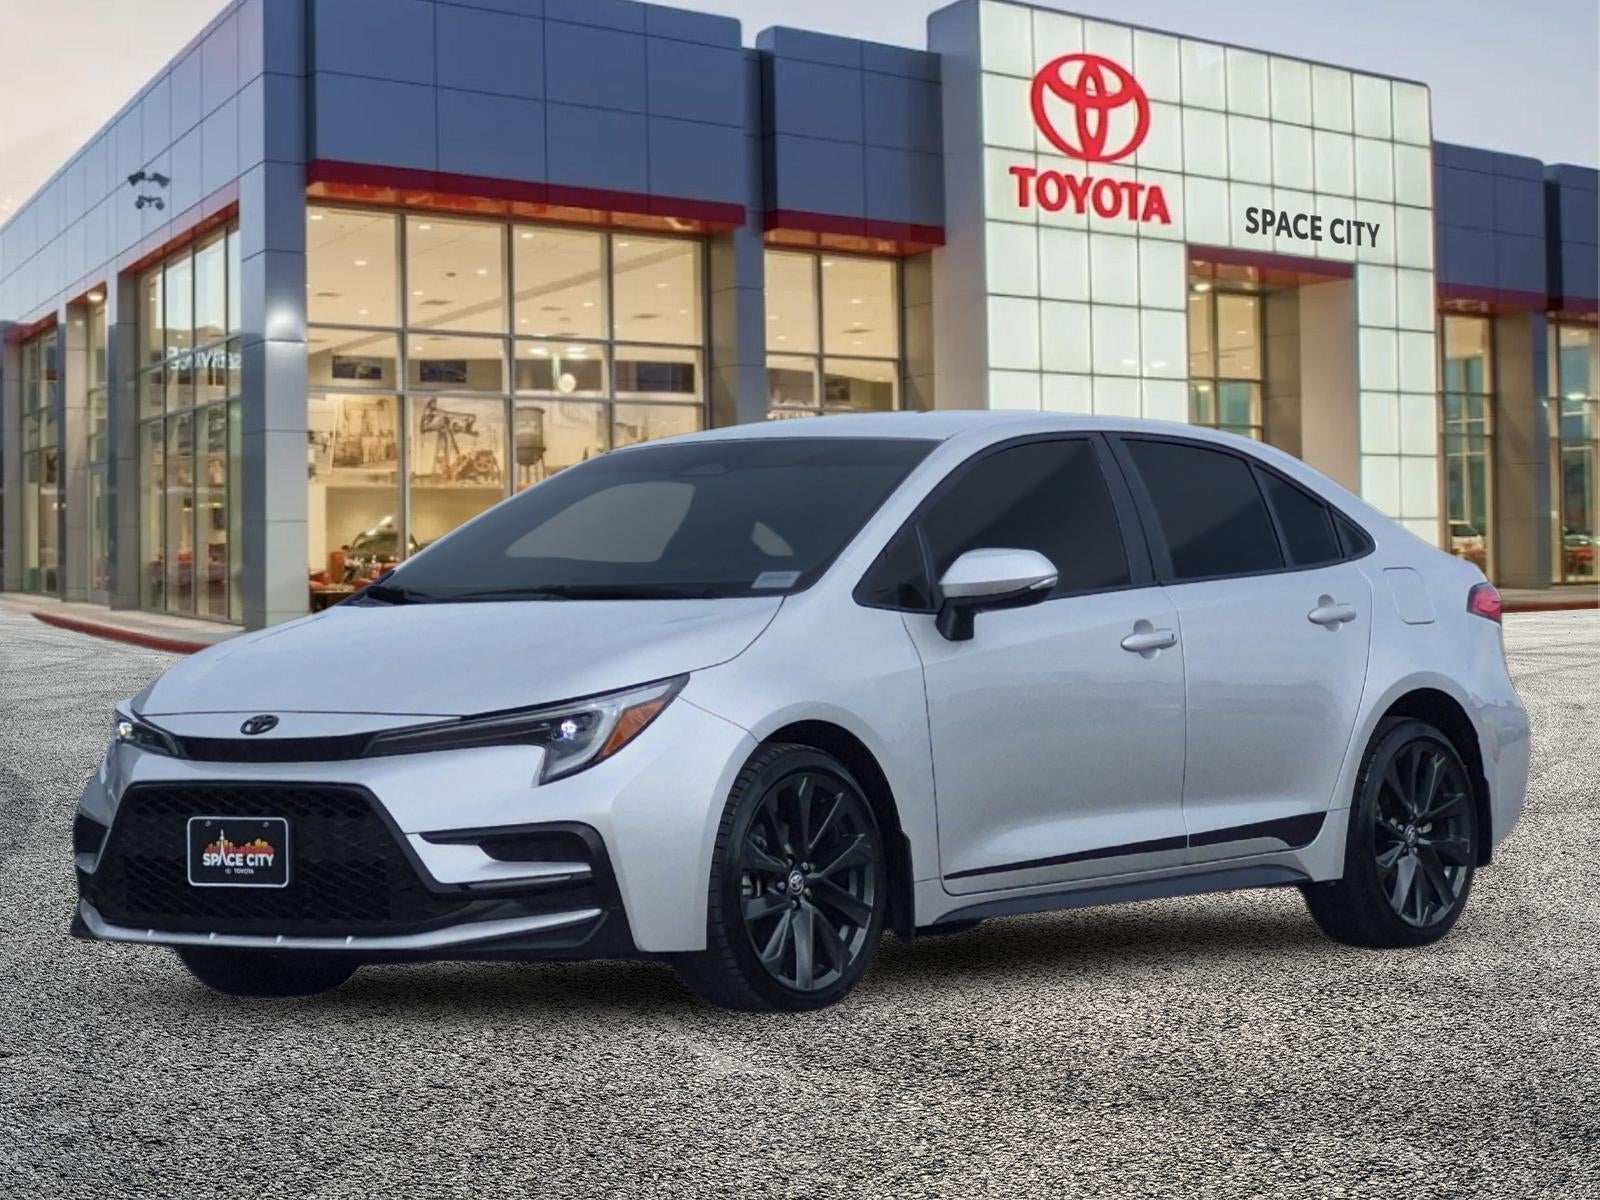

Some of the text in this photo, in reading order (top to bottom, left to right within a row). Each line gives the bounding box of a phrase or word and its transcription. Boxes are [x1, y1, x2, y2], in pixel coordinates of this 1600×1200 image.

[1009, 166, 1171, 225] TOYOTA
[1245, 206, 1381, 248] SPACE CITY
[203, 853, 274, 866] SPACE CITY
